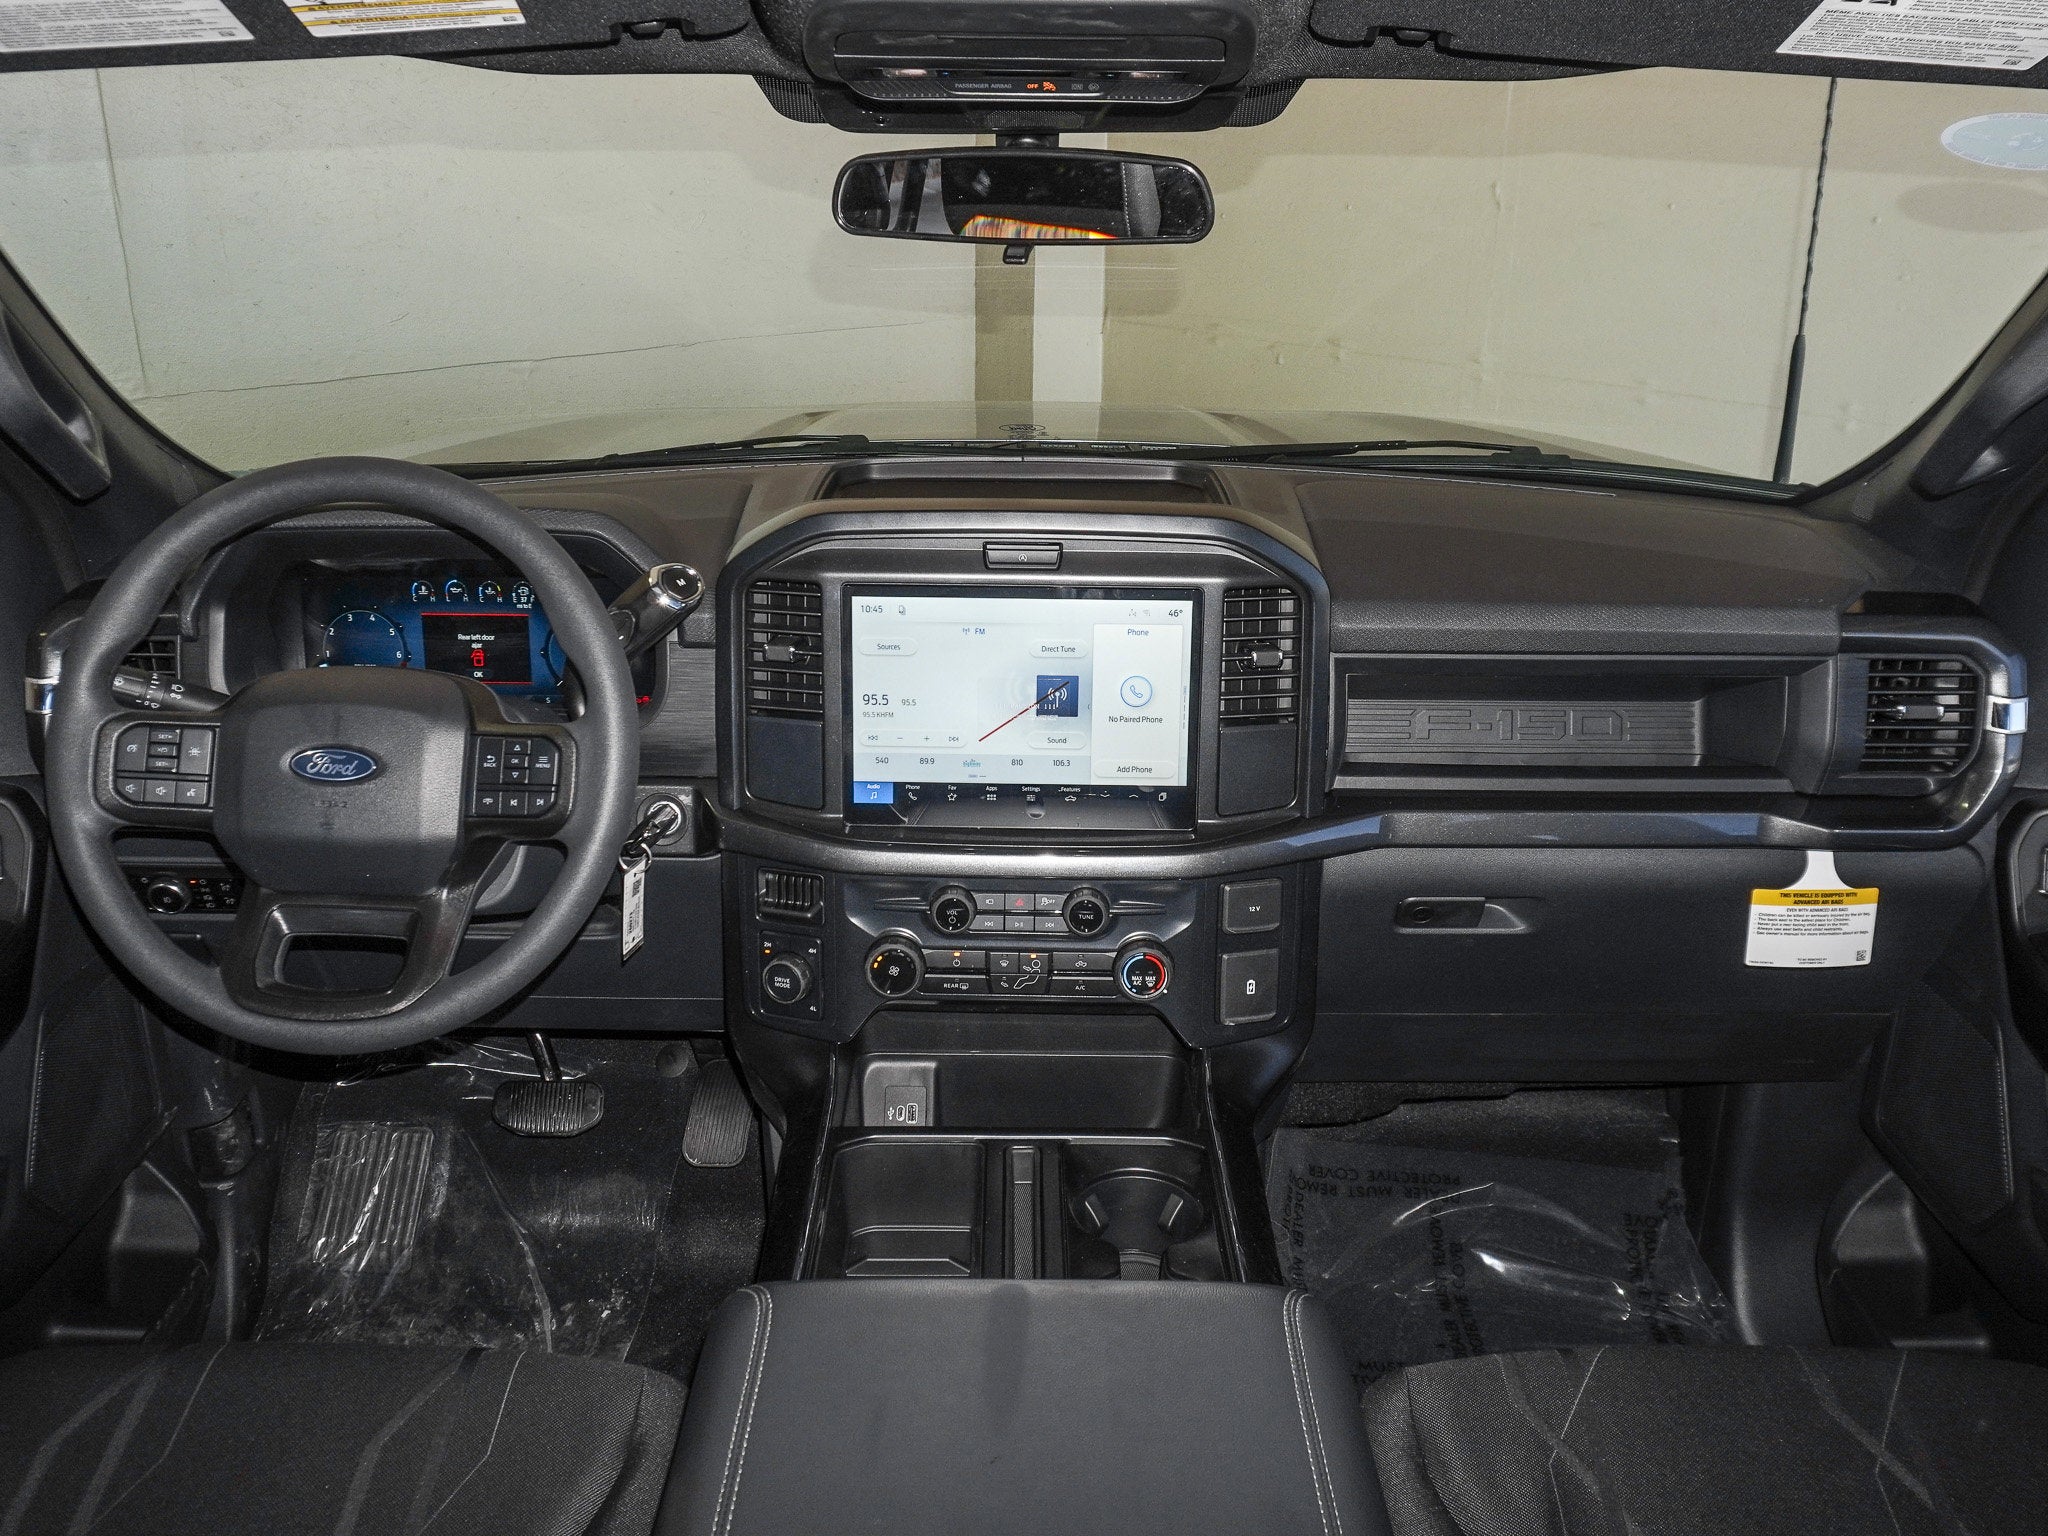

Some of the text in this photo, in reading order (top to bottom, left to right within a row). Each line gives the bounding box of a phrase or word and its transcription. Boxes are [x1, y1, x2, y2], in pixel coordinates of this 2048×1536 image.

[860, 604, 883, 614] 10:45
[1127, 628, 1149, 636] Phone
[876, 642, 901, 650] Sources
[1041, 645, 1076, 653] Direct Tune
[862, 693, 889, 706] 95.5
[1108, 715, 1163, 724] No Paired Phone
[1414, 708, 1623, 742] F-150
[1046, 736, 1068, 744] Sound
[306, 752, 359, 775] Ford
[875, 756, 889, 764] 540
[919, 757, 935, 765] 89.9
[1011, 759, 1024, 767] 810
[1116, 765, 1153, 774] Add Phone
[1021, 785, 1041, 793] Settings
[1308, 1163, 1461, 1187] PROTECTIVE COVER
[1347, 1185, 1392, 1198] MUST
